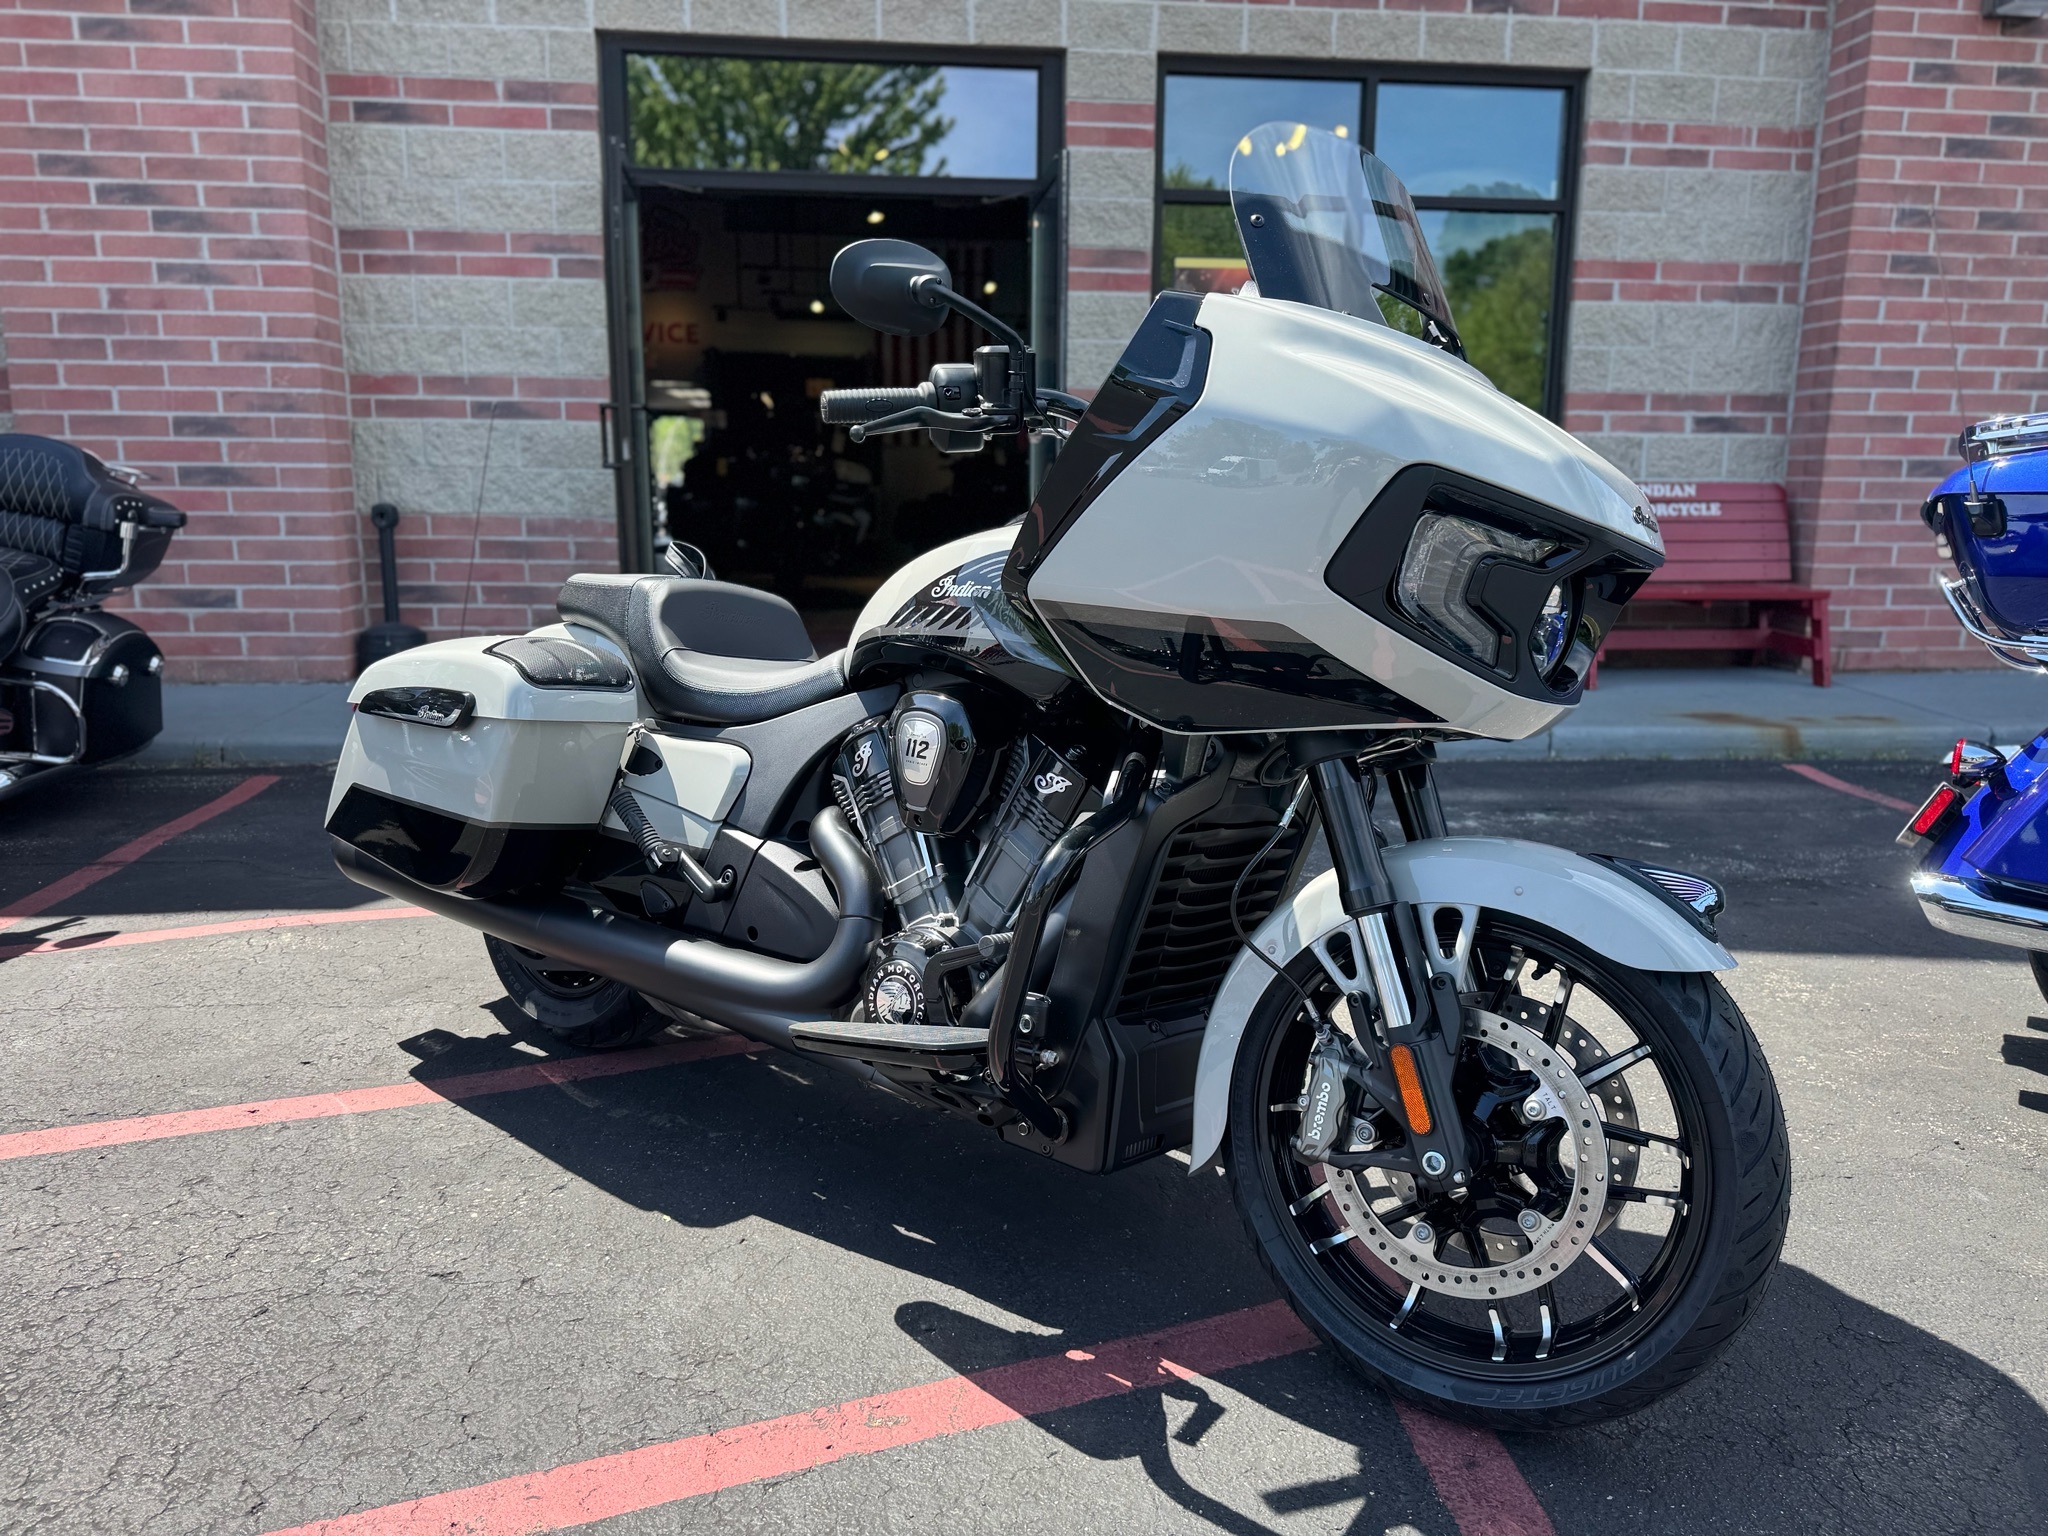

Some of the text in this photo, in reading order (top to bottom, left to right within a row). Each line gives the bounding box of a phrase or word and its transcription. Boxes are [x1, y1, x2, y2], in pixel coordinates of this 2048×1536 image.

[643, 322, 700, 344] VICE
[1639, 483, 1697, 498] NDIAN
[931, 575, 992, 599] Indian
[906, 738, 930, 760] 112
[868, 969, 885, 1018] INDIAN
[1307, 1082, 1331, 1141] brembo
[1476, 1344, 1657, 1402] CRUISETEC
